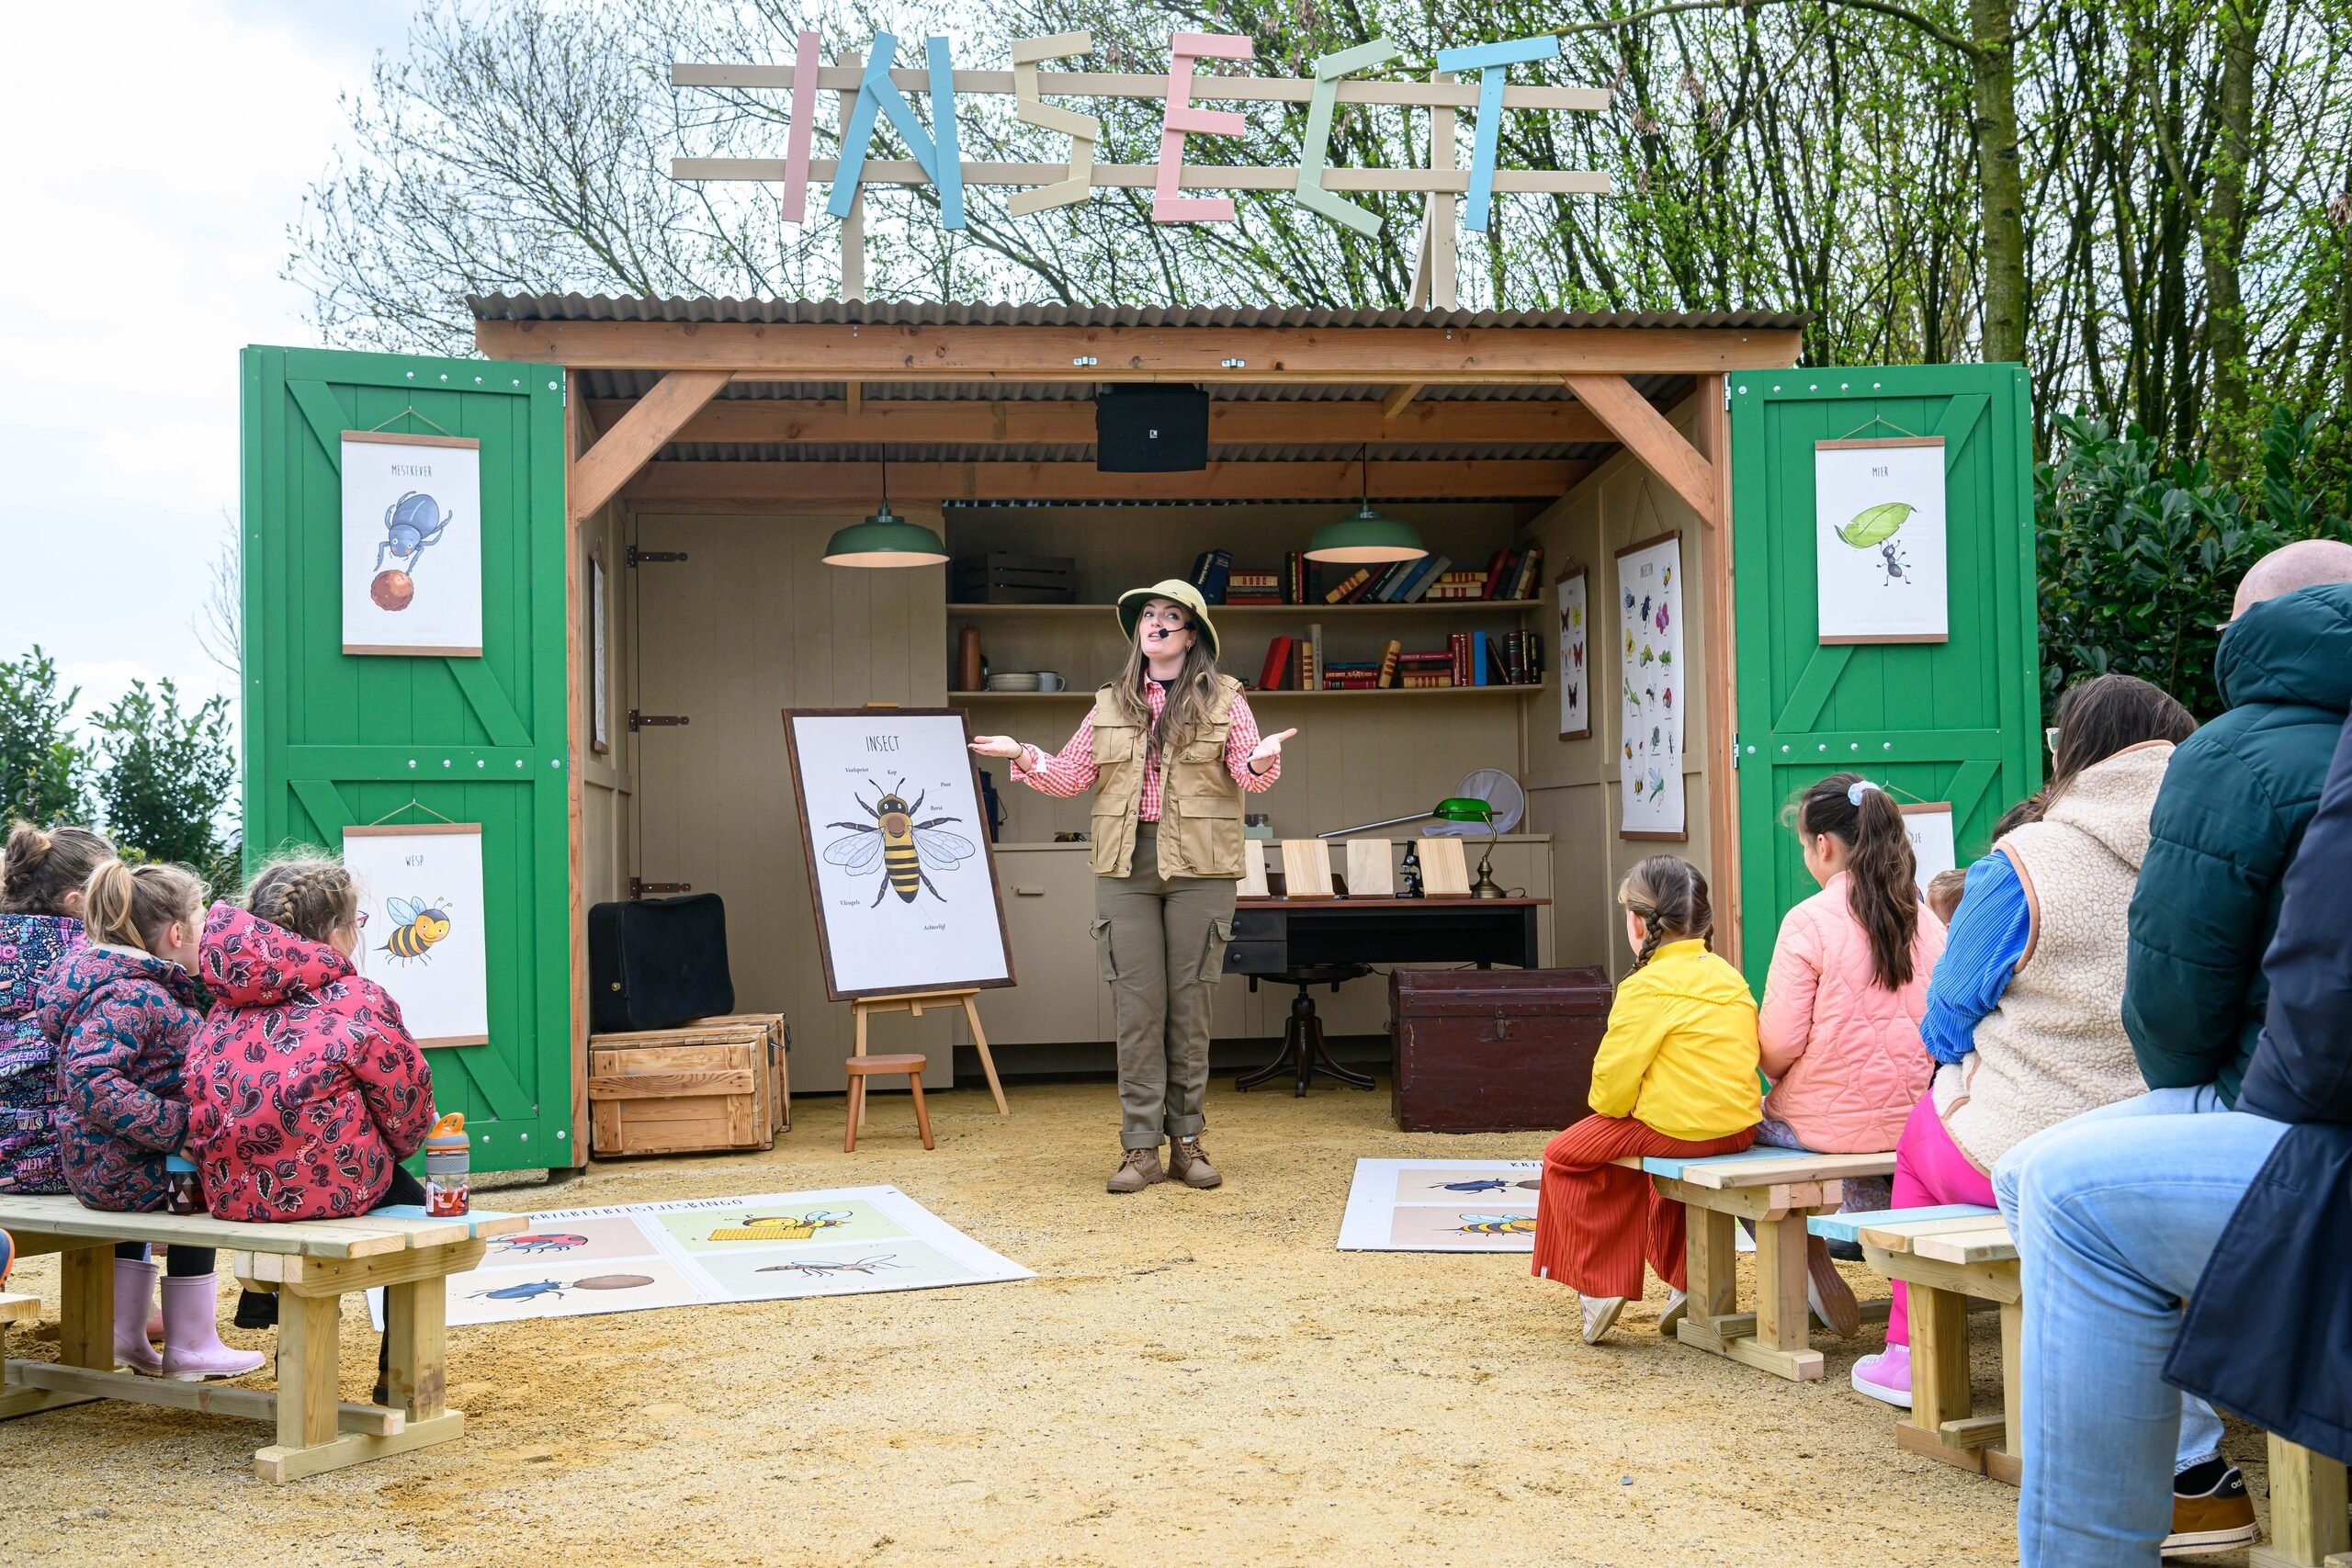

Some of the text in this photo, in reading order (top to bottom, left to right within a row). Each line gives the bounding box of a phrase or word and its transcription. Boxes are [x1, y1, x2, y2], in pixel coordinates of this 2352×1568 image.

[781, 30, 1559, 238] INSECT
[391, 464, 433, 477] MESTKEVER
[1872, 466, 1889, 478] MIER
[865, 735, 899, 751] INSECT
[405, 854, 424, 867] WESP
